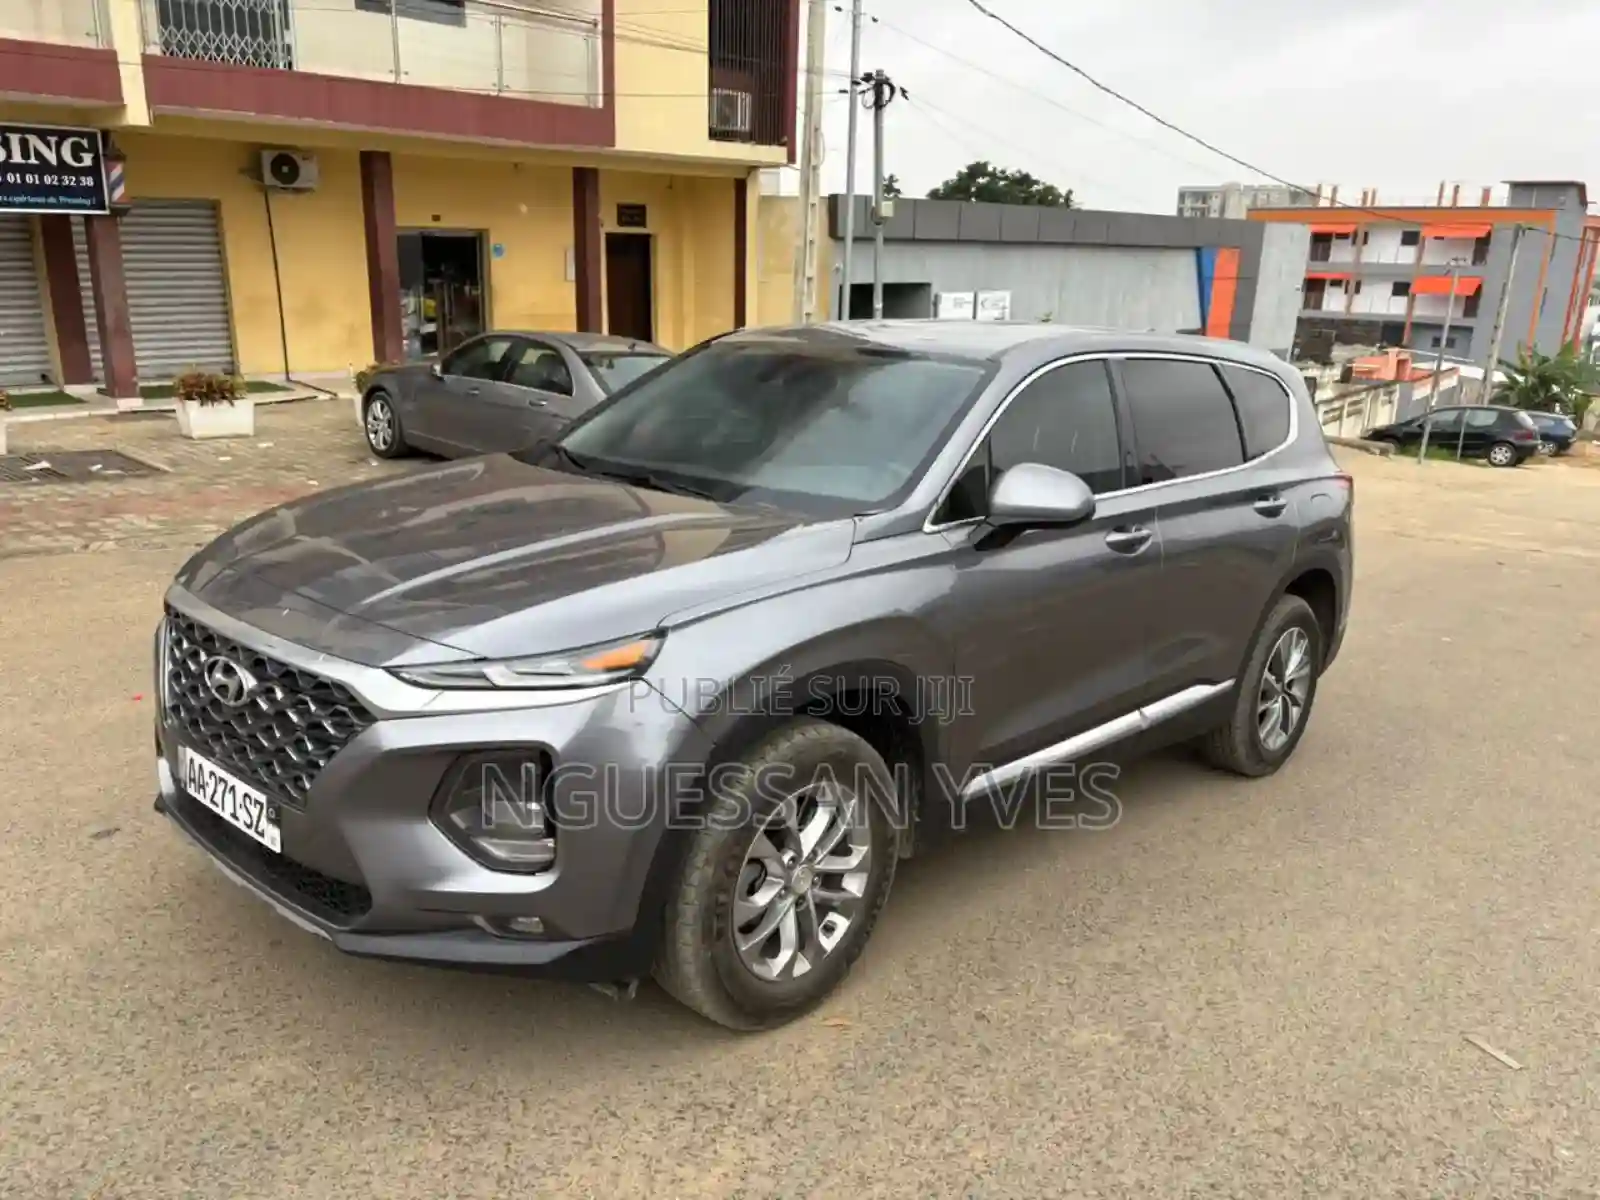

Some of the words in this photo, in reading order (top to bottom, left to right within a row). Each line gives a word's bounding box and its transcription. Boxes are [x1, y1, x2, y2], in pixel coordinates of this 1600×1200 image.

[0, 132, 94, 168] ING
[7, 172, 21, 184] 01
[25, 173, 40, 185] 01
[43, 174, 59, 186] 02
[61, 175, 76, 187] 32
[79, 175, 94, 187] 38
